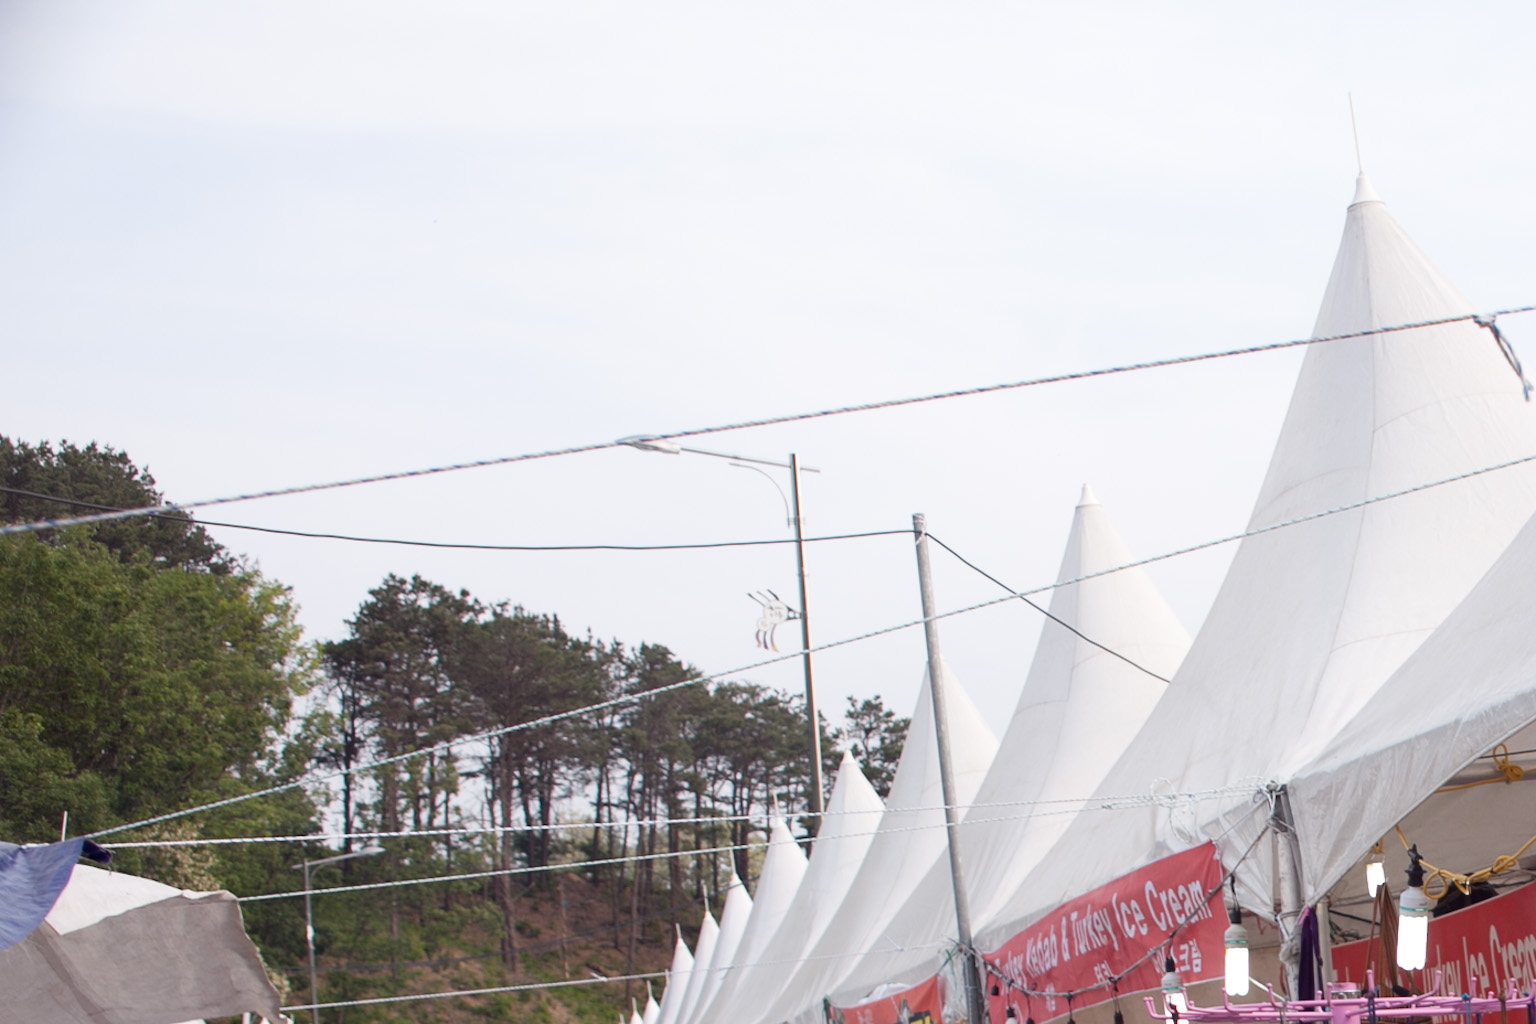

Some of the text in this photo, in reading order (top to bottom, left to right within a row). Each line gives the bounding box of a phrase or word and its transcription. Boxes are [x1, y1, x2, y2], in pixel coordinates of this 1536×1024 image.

[1026, 924, 1058, 979] Kebab
[1060, 916, 1072, 962] &
[1071, 903, 1120, 952] Turkey
[1112, 890, 1148, 939] Ice
[1144, 880, 1213, 932] Cream
